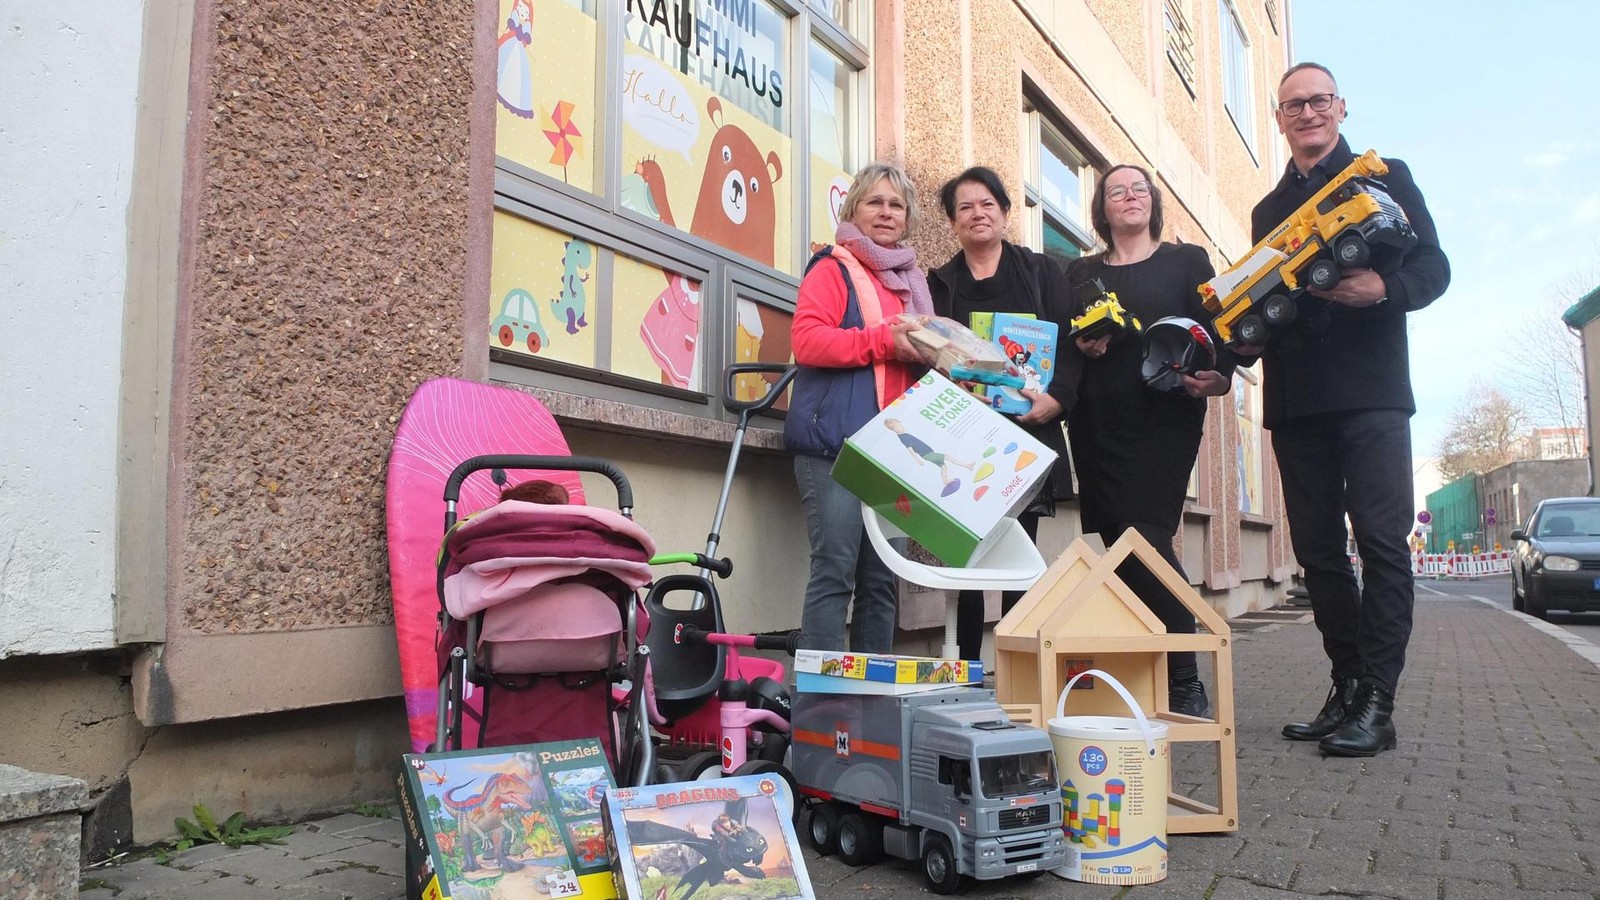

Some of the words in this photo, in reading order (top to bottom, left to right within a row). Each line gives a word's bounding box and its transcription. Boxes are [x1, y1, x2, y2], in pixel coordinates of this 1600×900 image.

[622, 69, 695, 125] Hallo
[920, 387, 961, 422] RIVER
[935, 397, 972, 430] STONES
[1001, 475, 1024, 498] GONGE
[411, 759, 425, 769] 4+
[539, 744, 601, 765] Puzzles
[1082, 753, 1104, 763] 130
[1087, 763, 1100, 773] pcs
[398, 772, 419, 840] Puzzles
[656, 787, 740, 809] DRAGONS
[1015, 809, 1036, 818] MAN
[559, 882, 578, 894] 24
